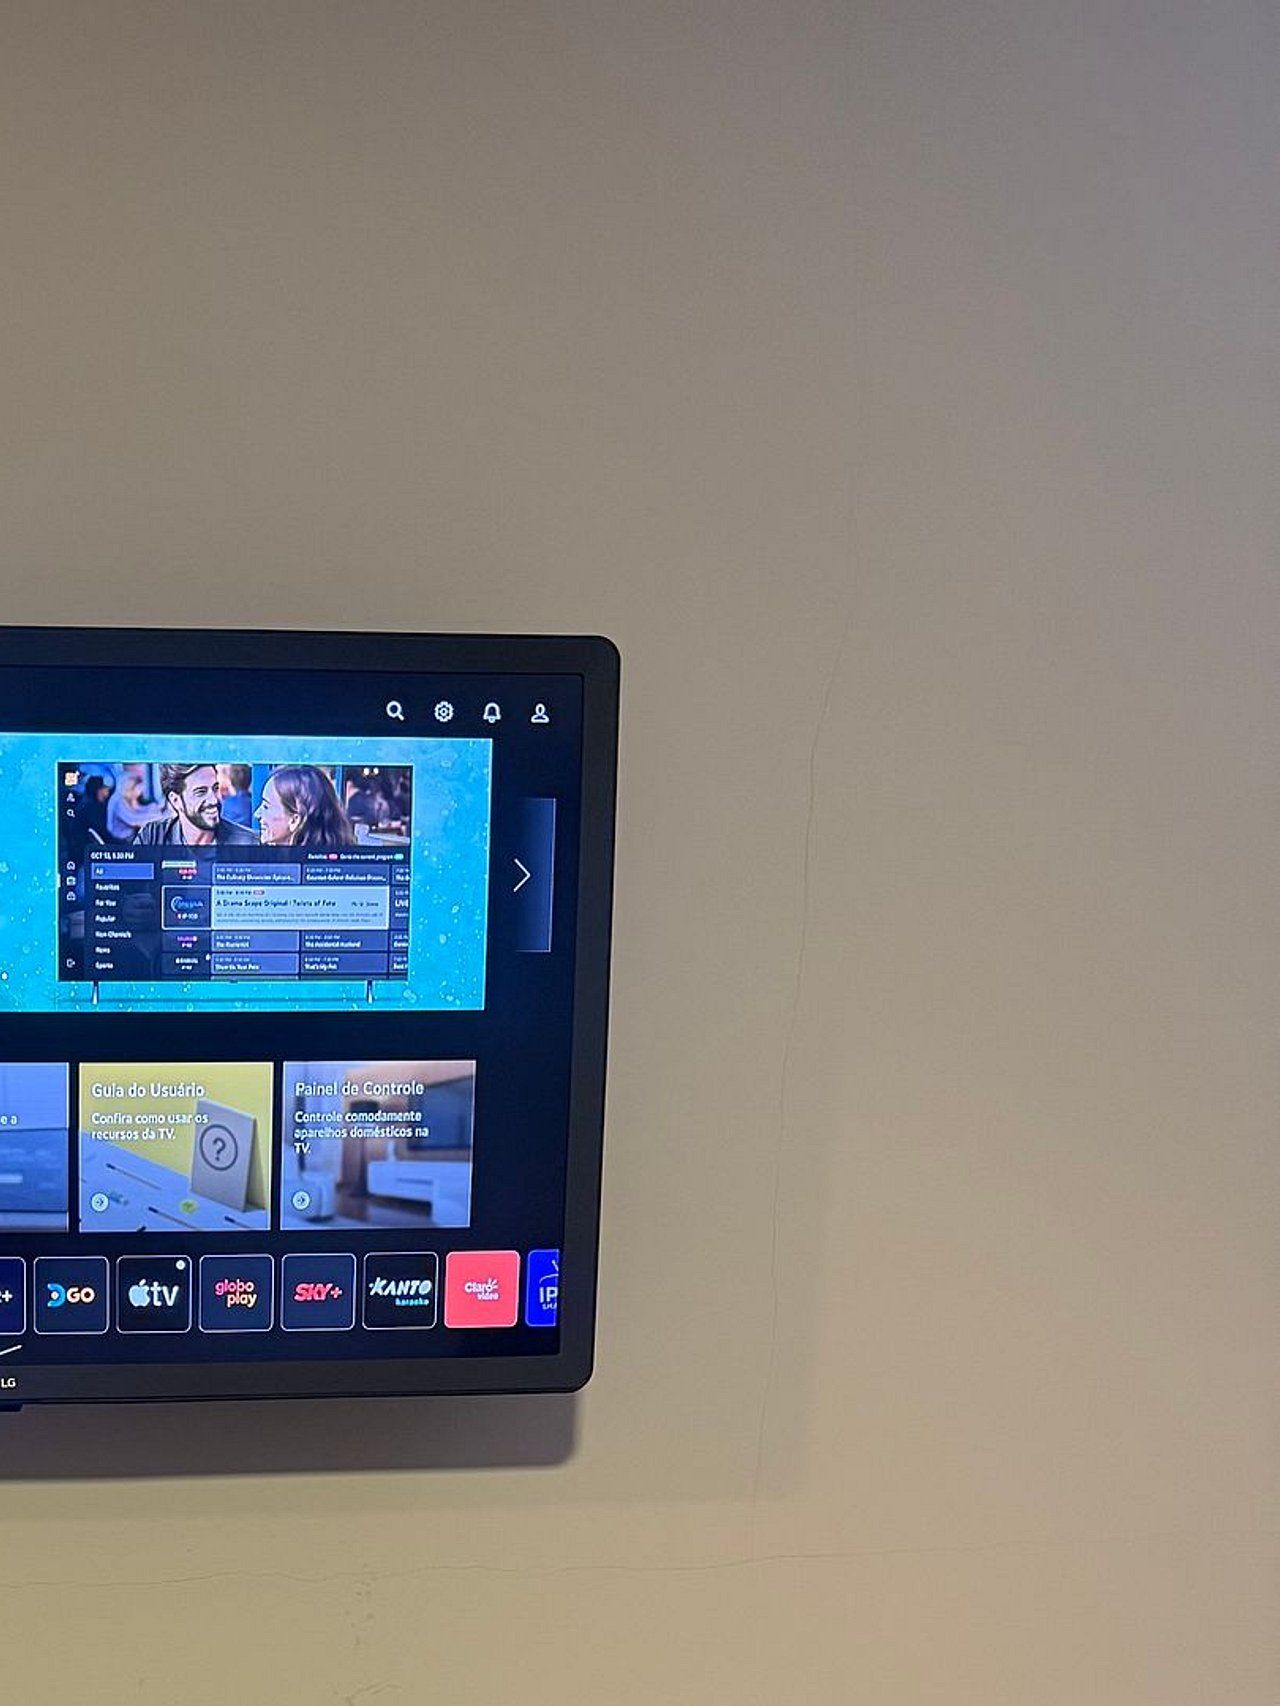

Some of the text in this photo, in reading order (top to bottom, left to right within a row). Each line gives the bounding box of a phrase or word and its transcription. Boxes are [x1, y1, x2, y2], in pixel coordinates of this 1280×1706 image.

[92, 1082, 205, 1097] Guia do Usuário
[295, 1081, 424, 1096] Painel de Controle
[0, 1116, 8, 1125] e
[10, 1116, 18, 1125] a
[91, 1113, 209, 1125] Confira como usar os
[294, 1110, 422, 1123] Controle comodamente
[91, 1128, 177, 1140] recursos da TV.
[294, 1125, 429, 1140] aparelhos domésticos na
[294, 1142, 311, 1154] TV.
[215, 1278, 254, 1296] globo
[369, 1277, 432, 1296] KANTO
[226, 1291, 257, 1308] play
[0, 1377, 17, 1388] LG
